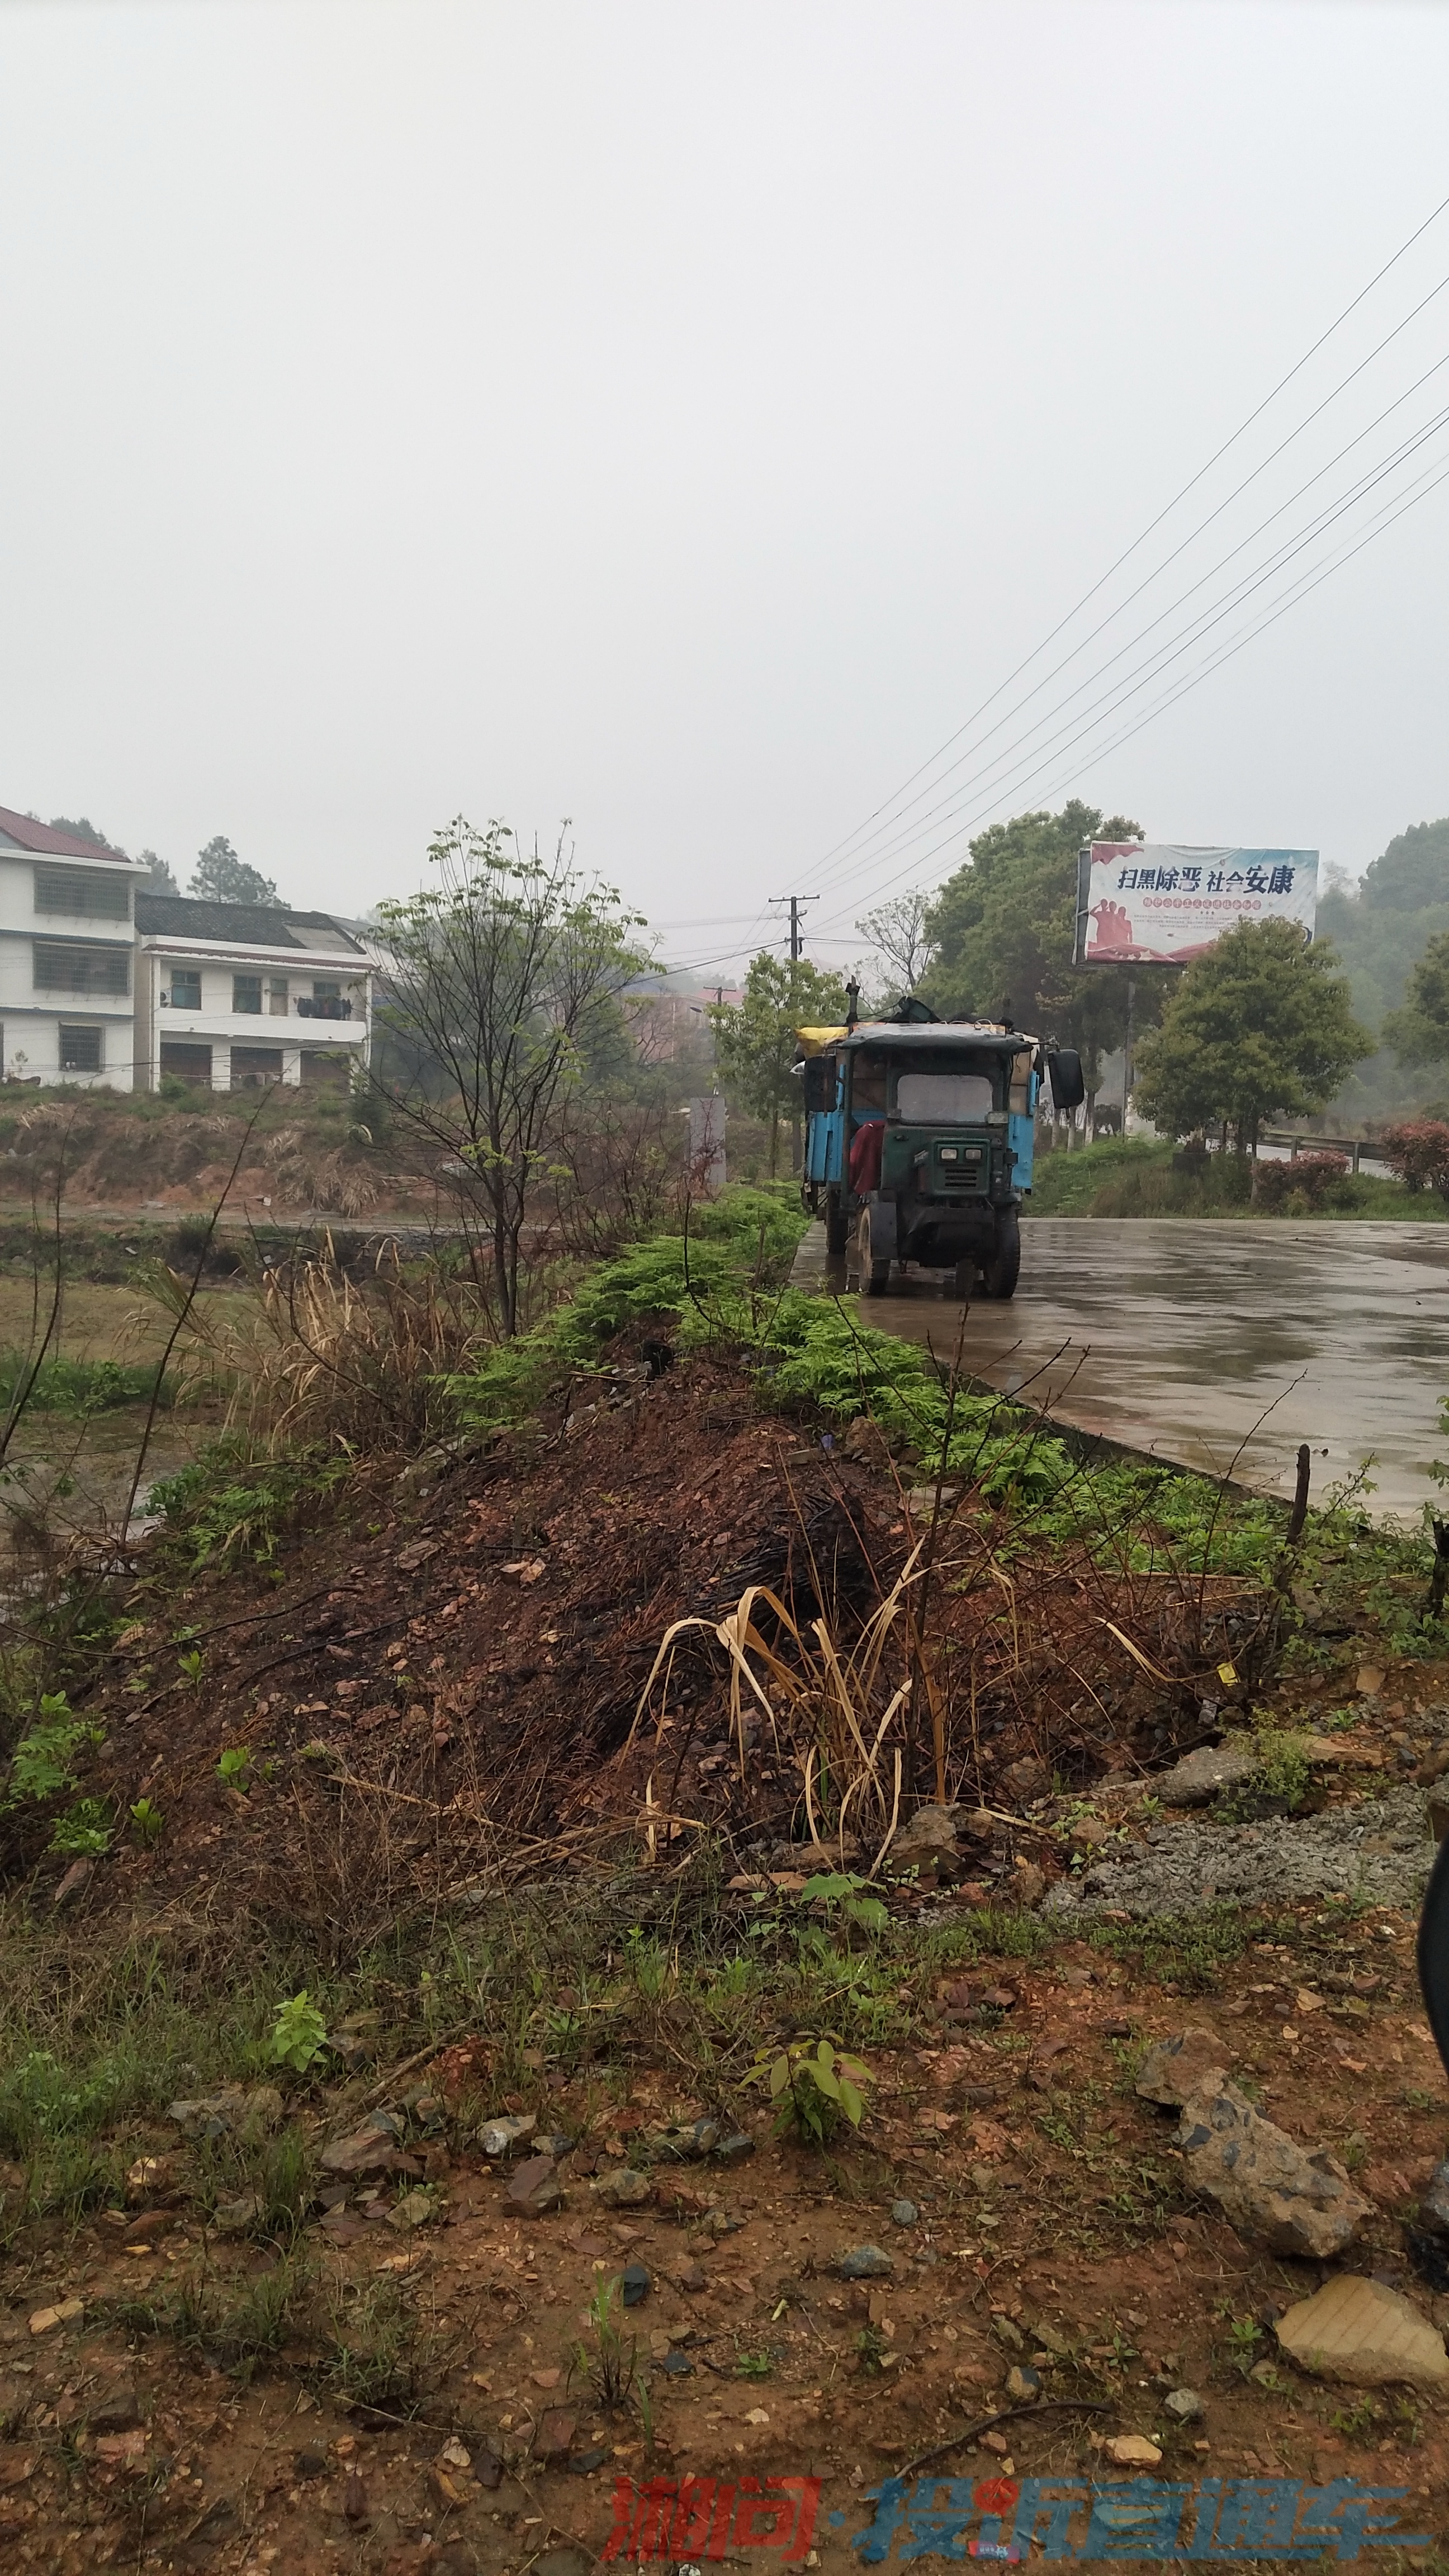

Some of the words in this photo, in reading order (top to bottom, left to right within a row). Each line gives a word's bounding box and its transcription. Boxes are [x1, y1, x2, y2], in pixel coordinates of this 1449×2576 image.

[1117, 866, 1202, 892] 扫黑除恶
[1206, 865, 1295, 893] 社会安康
